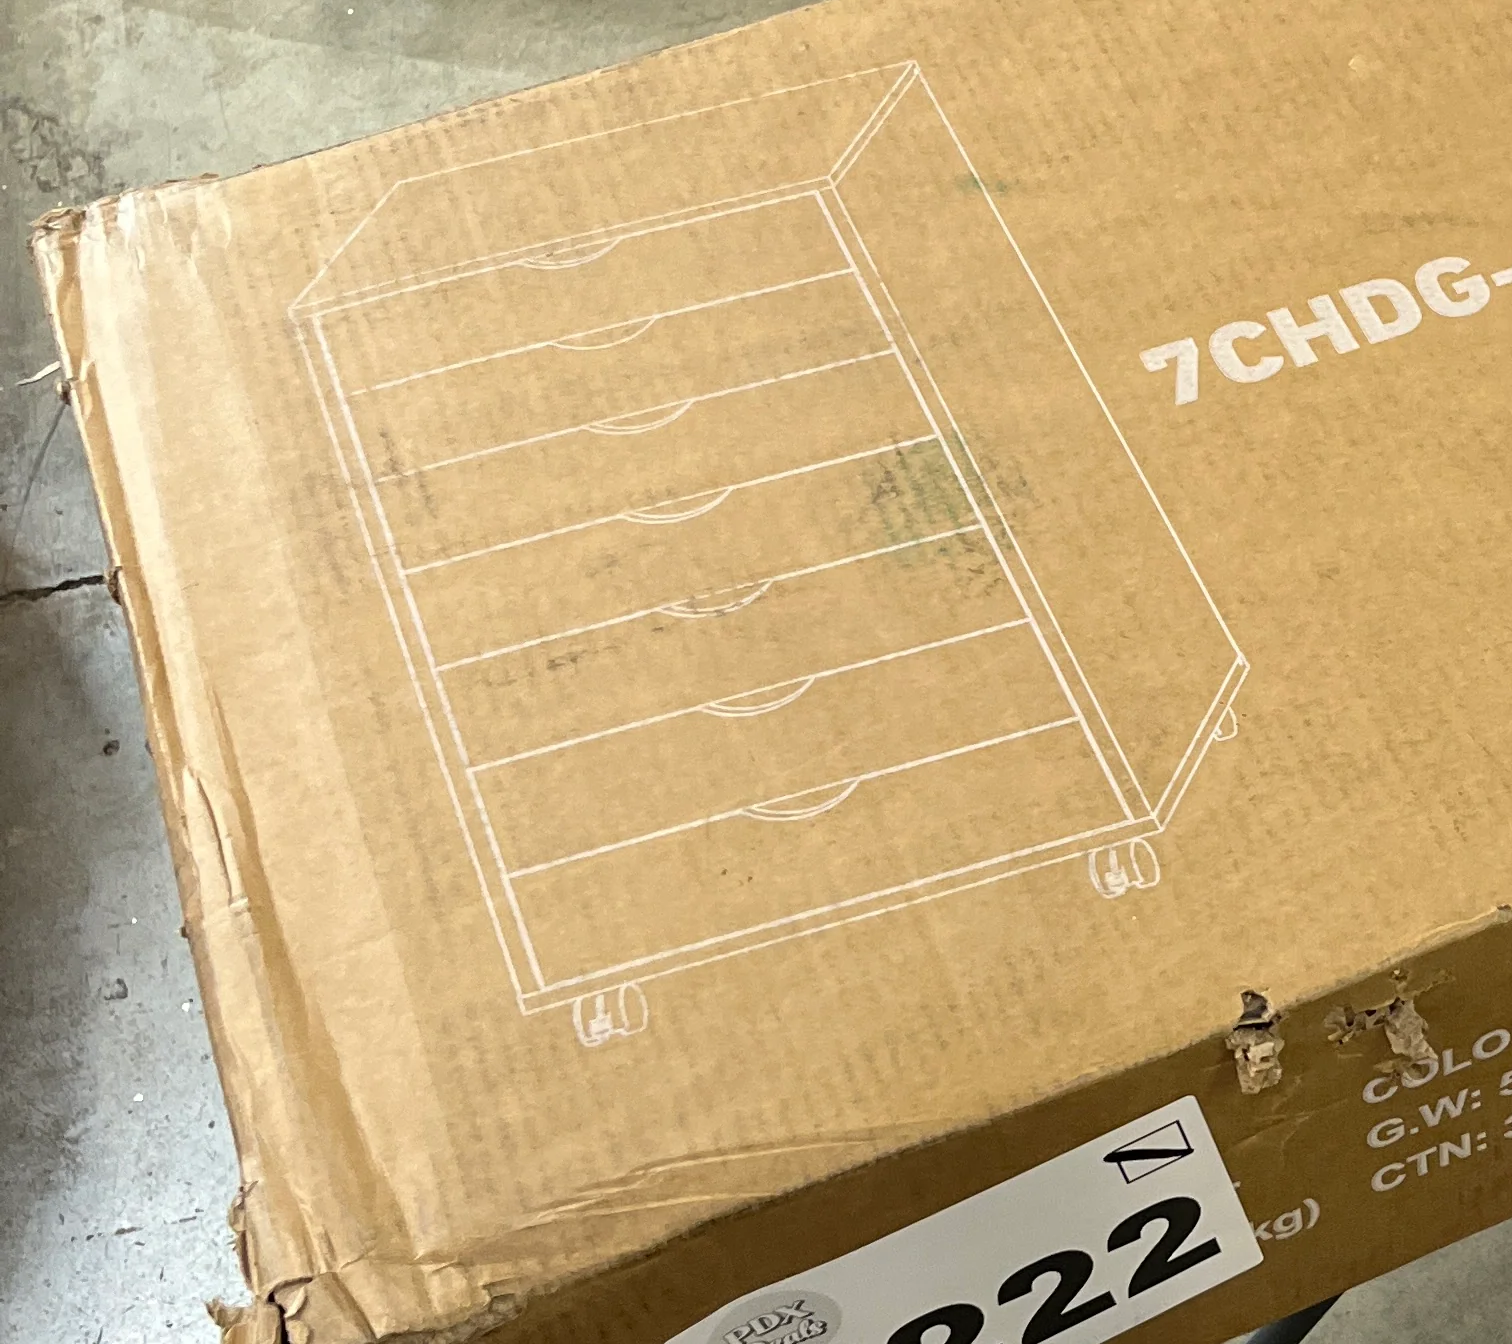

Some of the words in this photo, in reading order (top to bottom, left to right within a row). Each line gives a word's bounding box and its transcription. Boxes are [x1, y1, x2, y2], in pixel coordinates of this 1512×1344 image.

[1365, 1088, 1482, 1149] G.W:
[1369, 1132, 1489, 1193] CTN:
[1252, 1196, 1323, 1243] kg)
